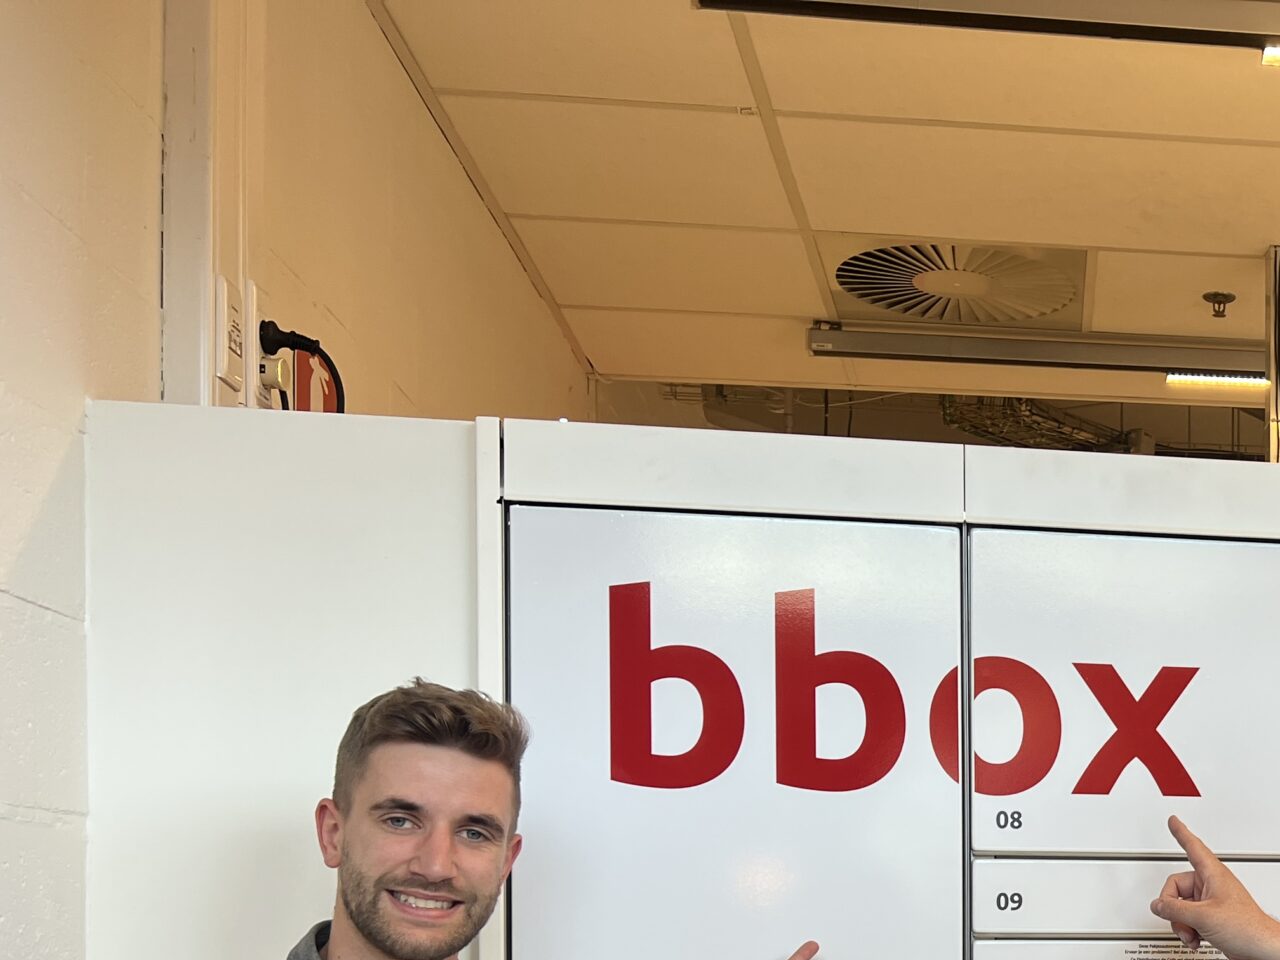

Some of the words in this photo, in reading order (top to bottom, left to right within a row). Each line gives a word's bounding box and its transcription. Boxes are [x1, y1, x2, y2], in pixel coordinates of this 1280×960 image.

[609, 581, 1201, 797] bbox
[995, 811, 1023, 829] 08
[996, 892, 1023, 911] 09
